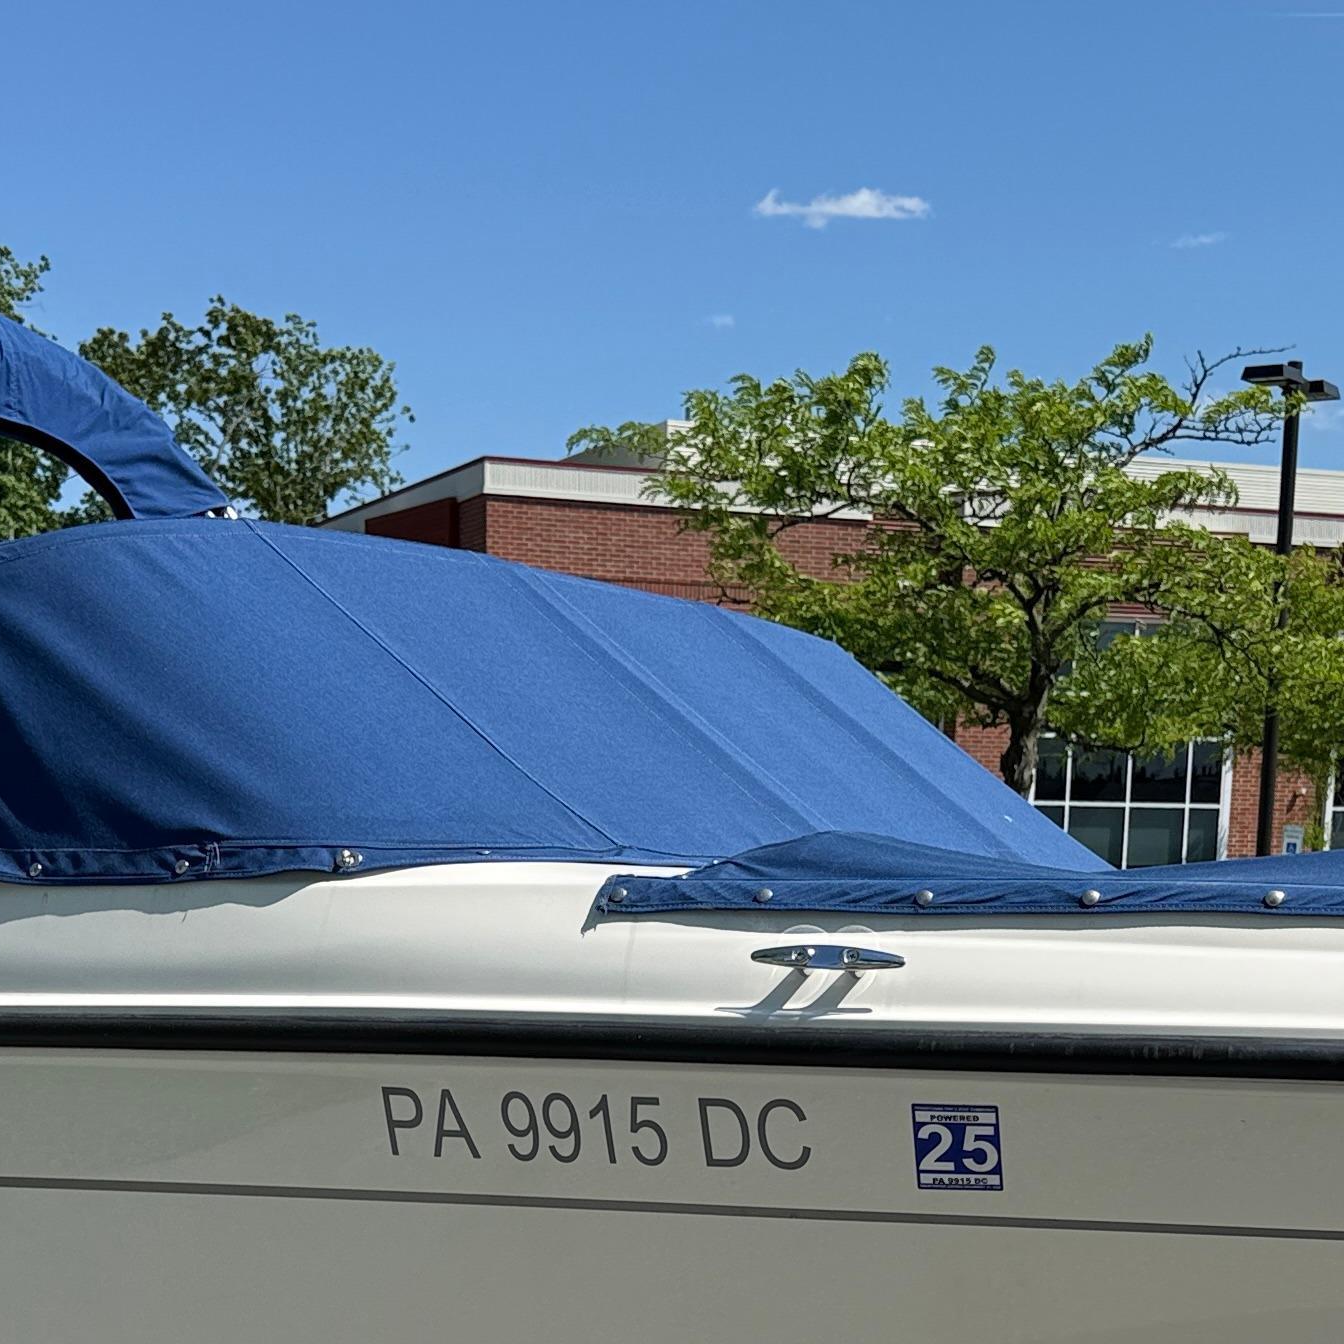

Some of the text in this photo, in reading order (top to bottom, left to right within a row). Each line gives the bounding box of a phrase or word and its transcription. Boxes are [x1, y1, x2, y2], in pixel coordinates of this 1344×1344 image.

[381, 1086, 811, 1170] PA 9915 DC
[930, 1114, 979, 1122] POWERED
[918, 1124, 998, 1172] 25
